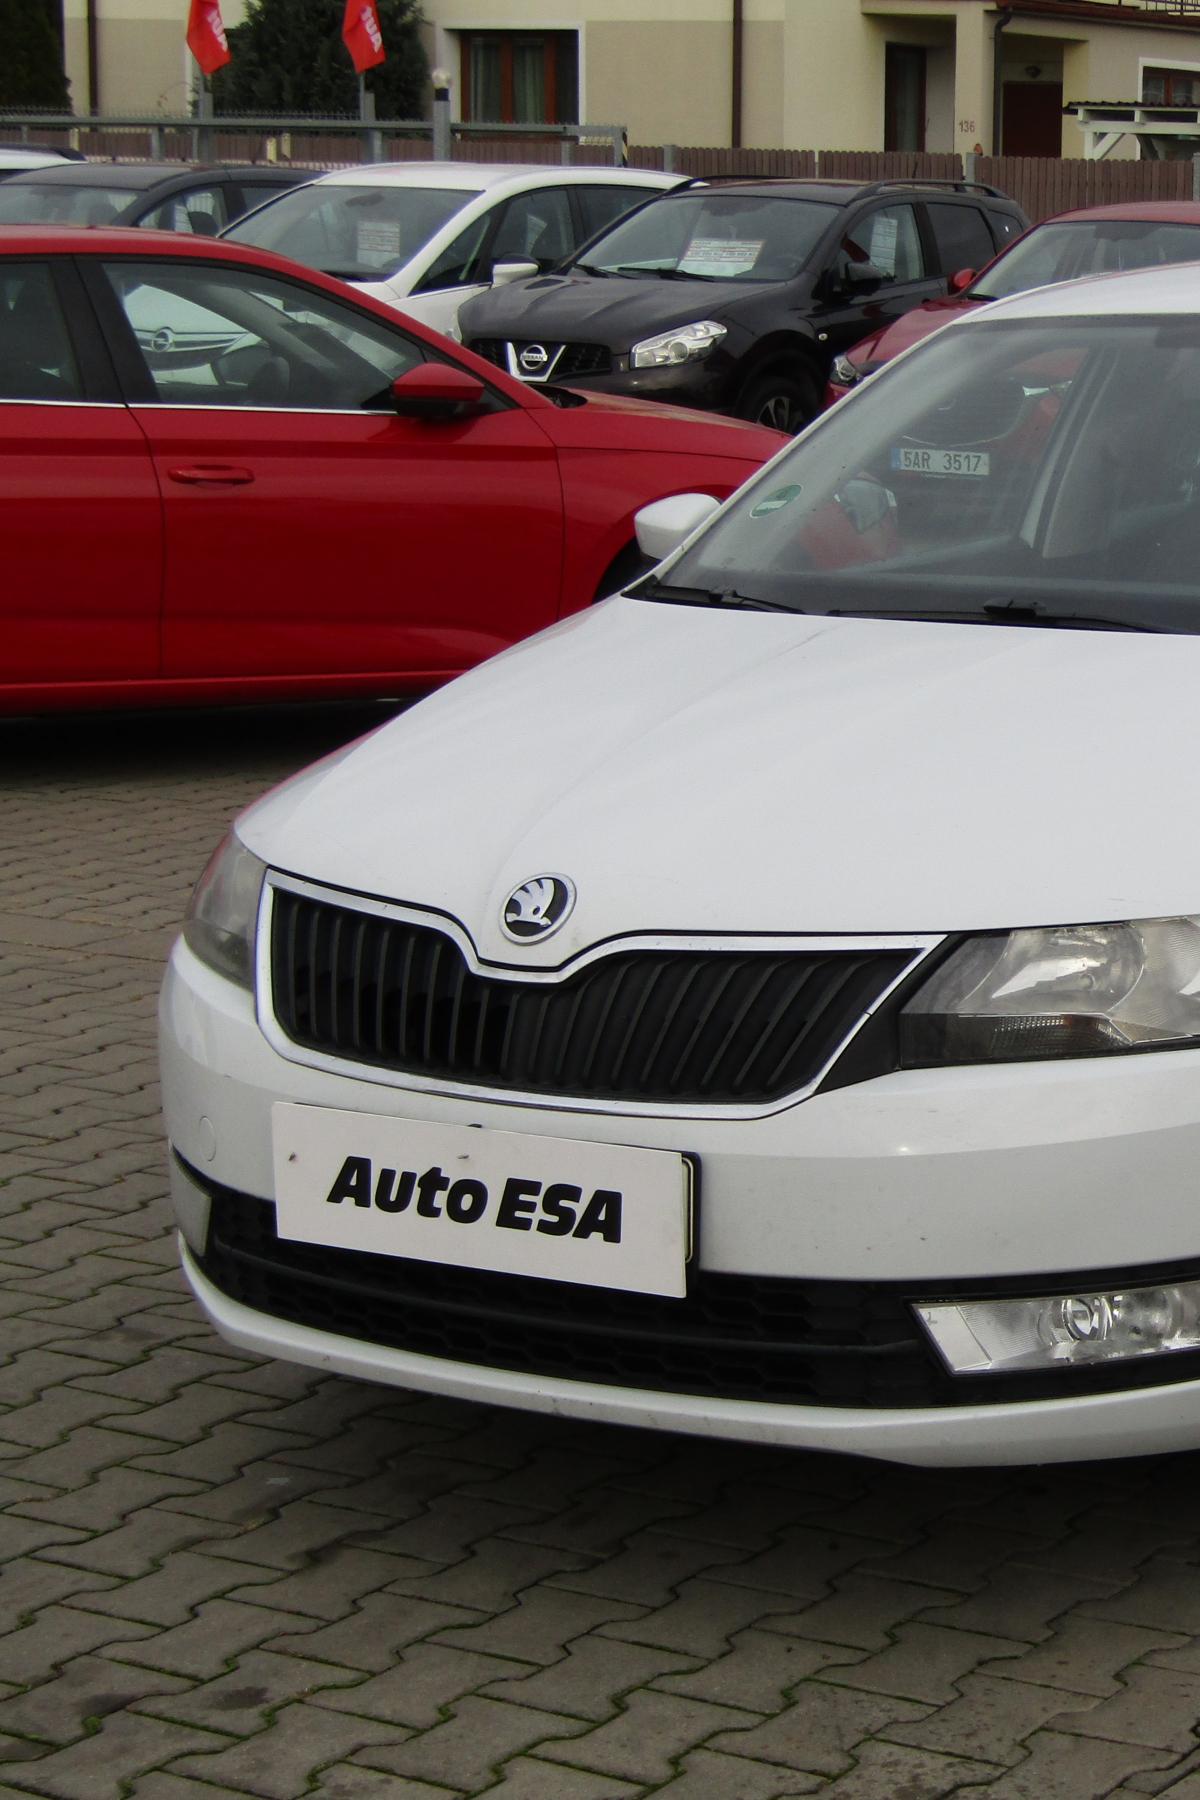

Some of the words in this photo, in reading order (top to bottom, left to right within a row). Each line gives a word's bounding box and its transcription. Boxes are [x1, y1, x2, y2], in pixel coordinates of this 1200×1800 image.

[959, 120, 976, 133] 136
[903, 450, 931, 470] 5AR
[943, 452, 982, 473] 3517
[326, 1155, 489, 1224] Auto
[495, 1177, 623, 1244] ESA
